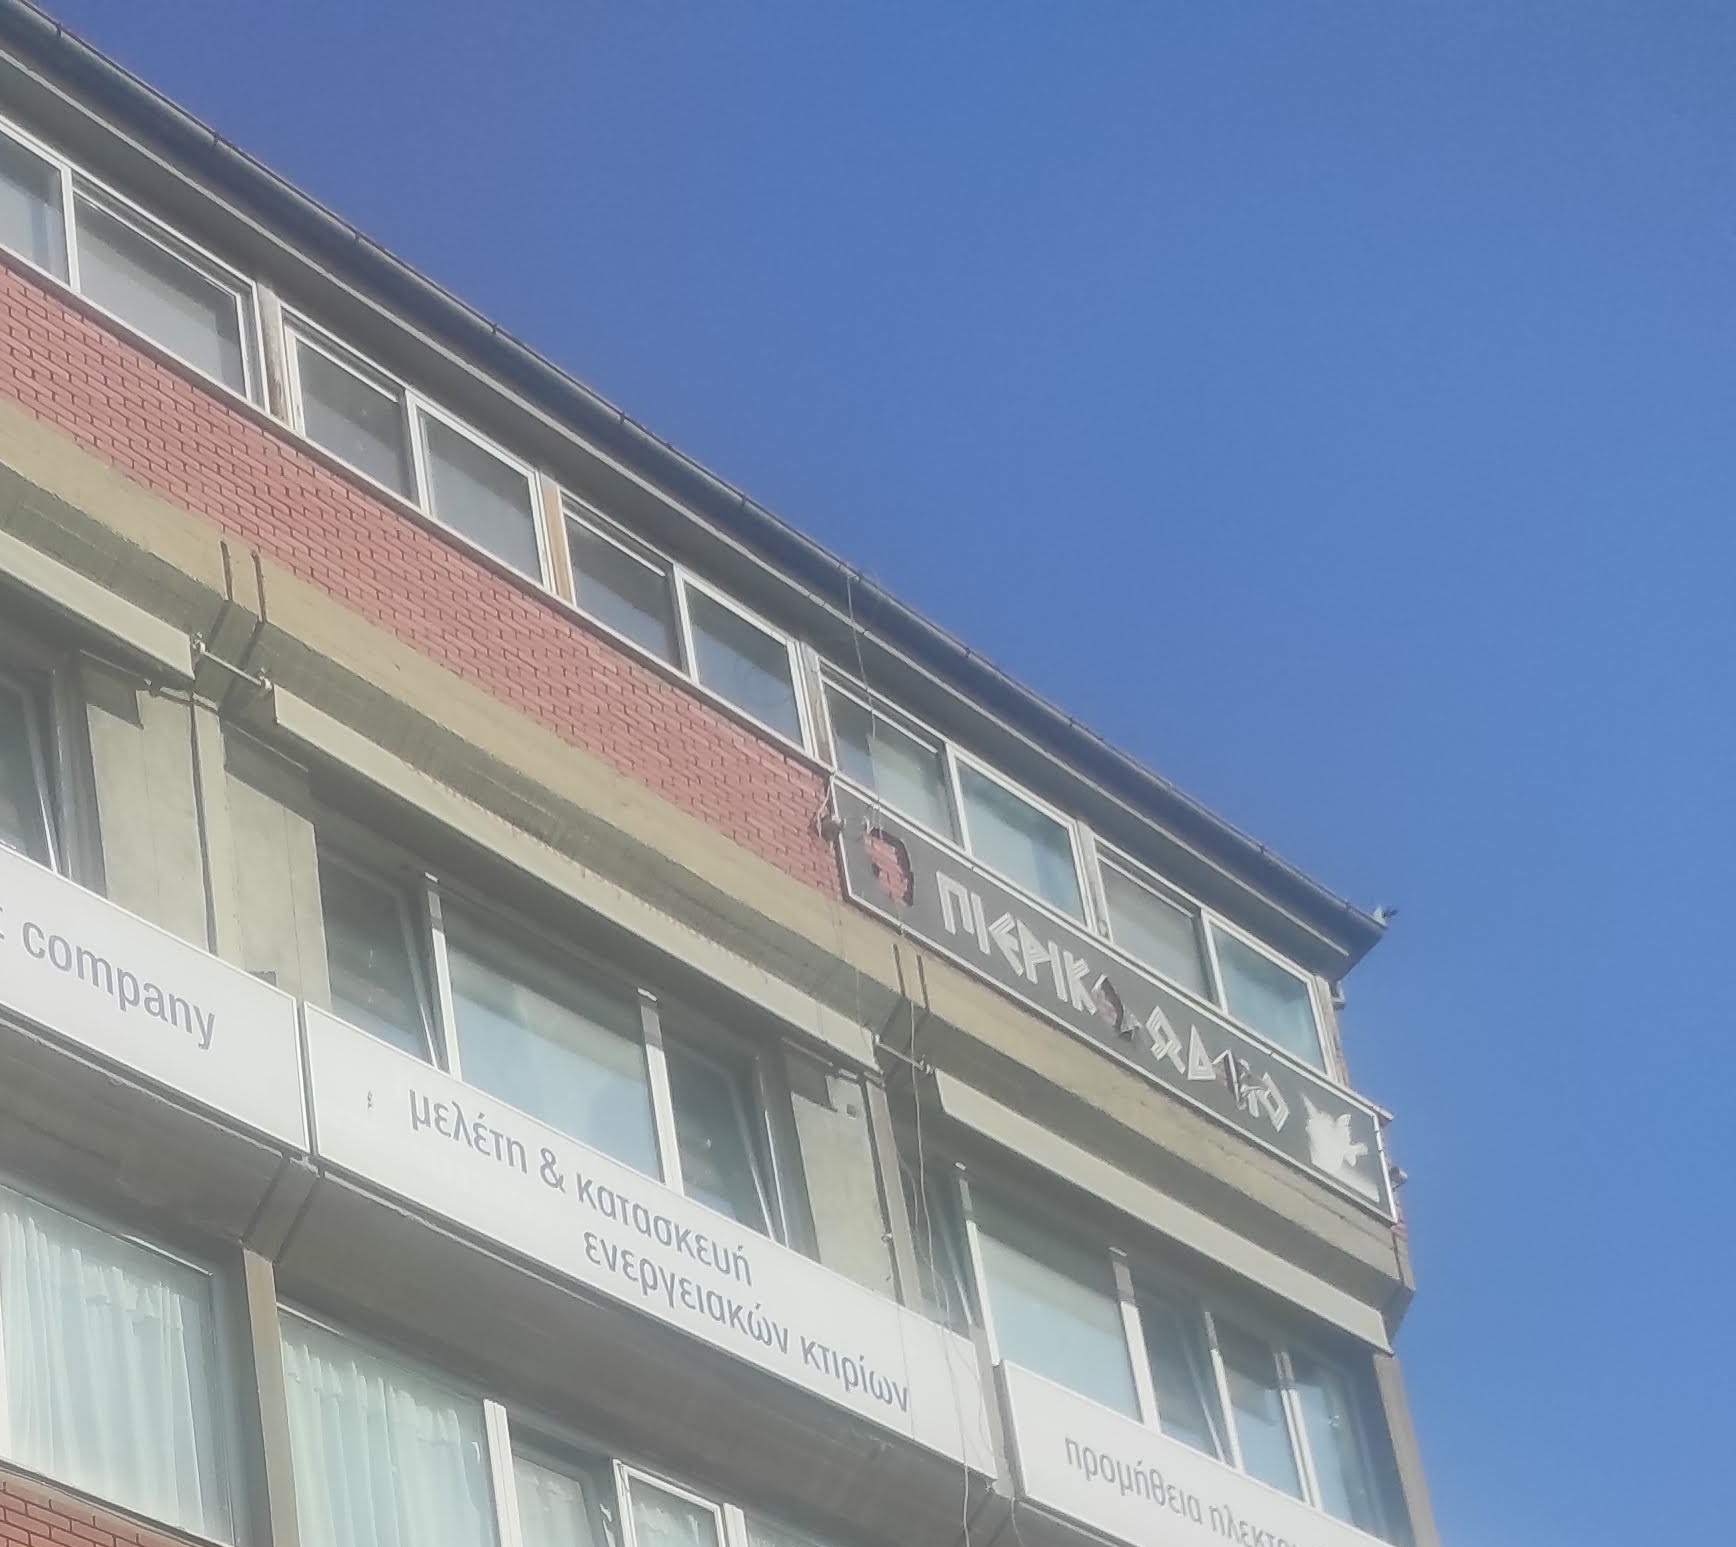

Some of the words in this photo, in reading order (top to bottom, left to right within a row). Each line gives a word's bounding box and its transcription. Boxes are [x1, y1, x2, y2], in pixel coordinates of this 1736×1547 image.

[20, 914, 217, 1053] company
[407, 1086, 529, 1179] μελέτη
[539, 1147, 568, 1192] &
[576, 1171, 755, 1288] κατασκευή
[582, 1229, 791, 1355] ενεργειακών
[800, 1333, 910, 1413] κτιρίων
[1065, 1436, 1204, 1525] προμήθεια
